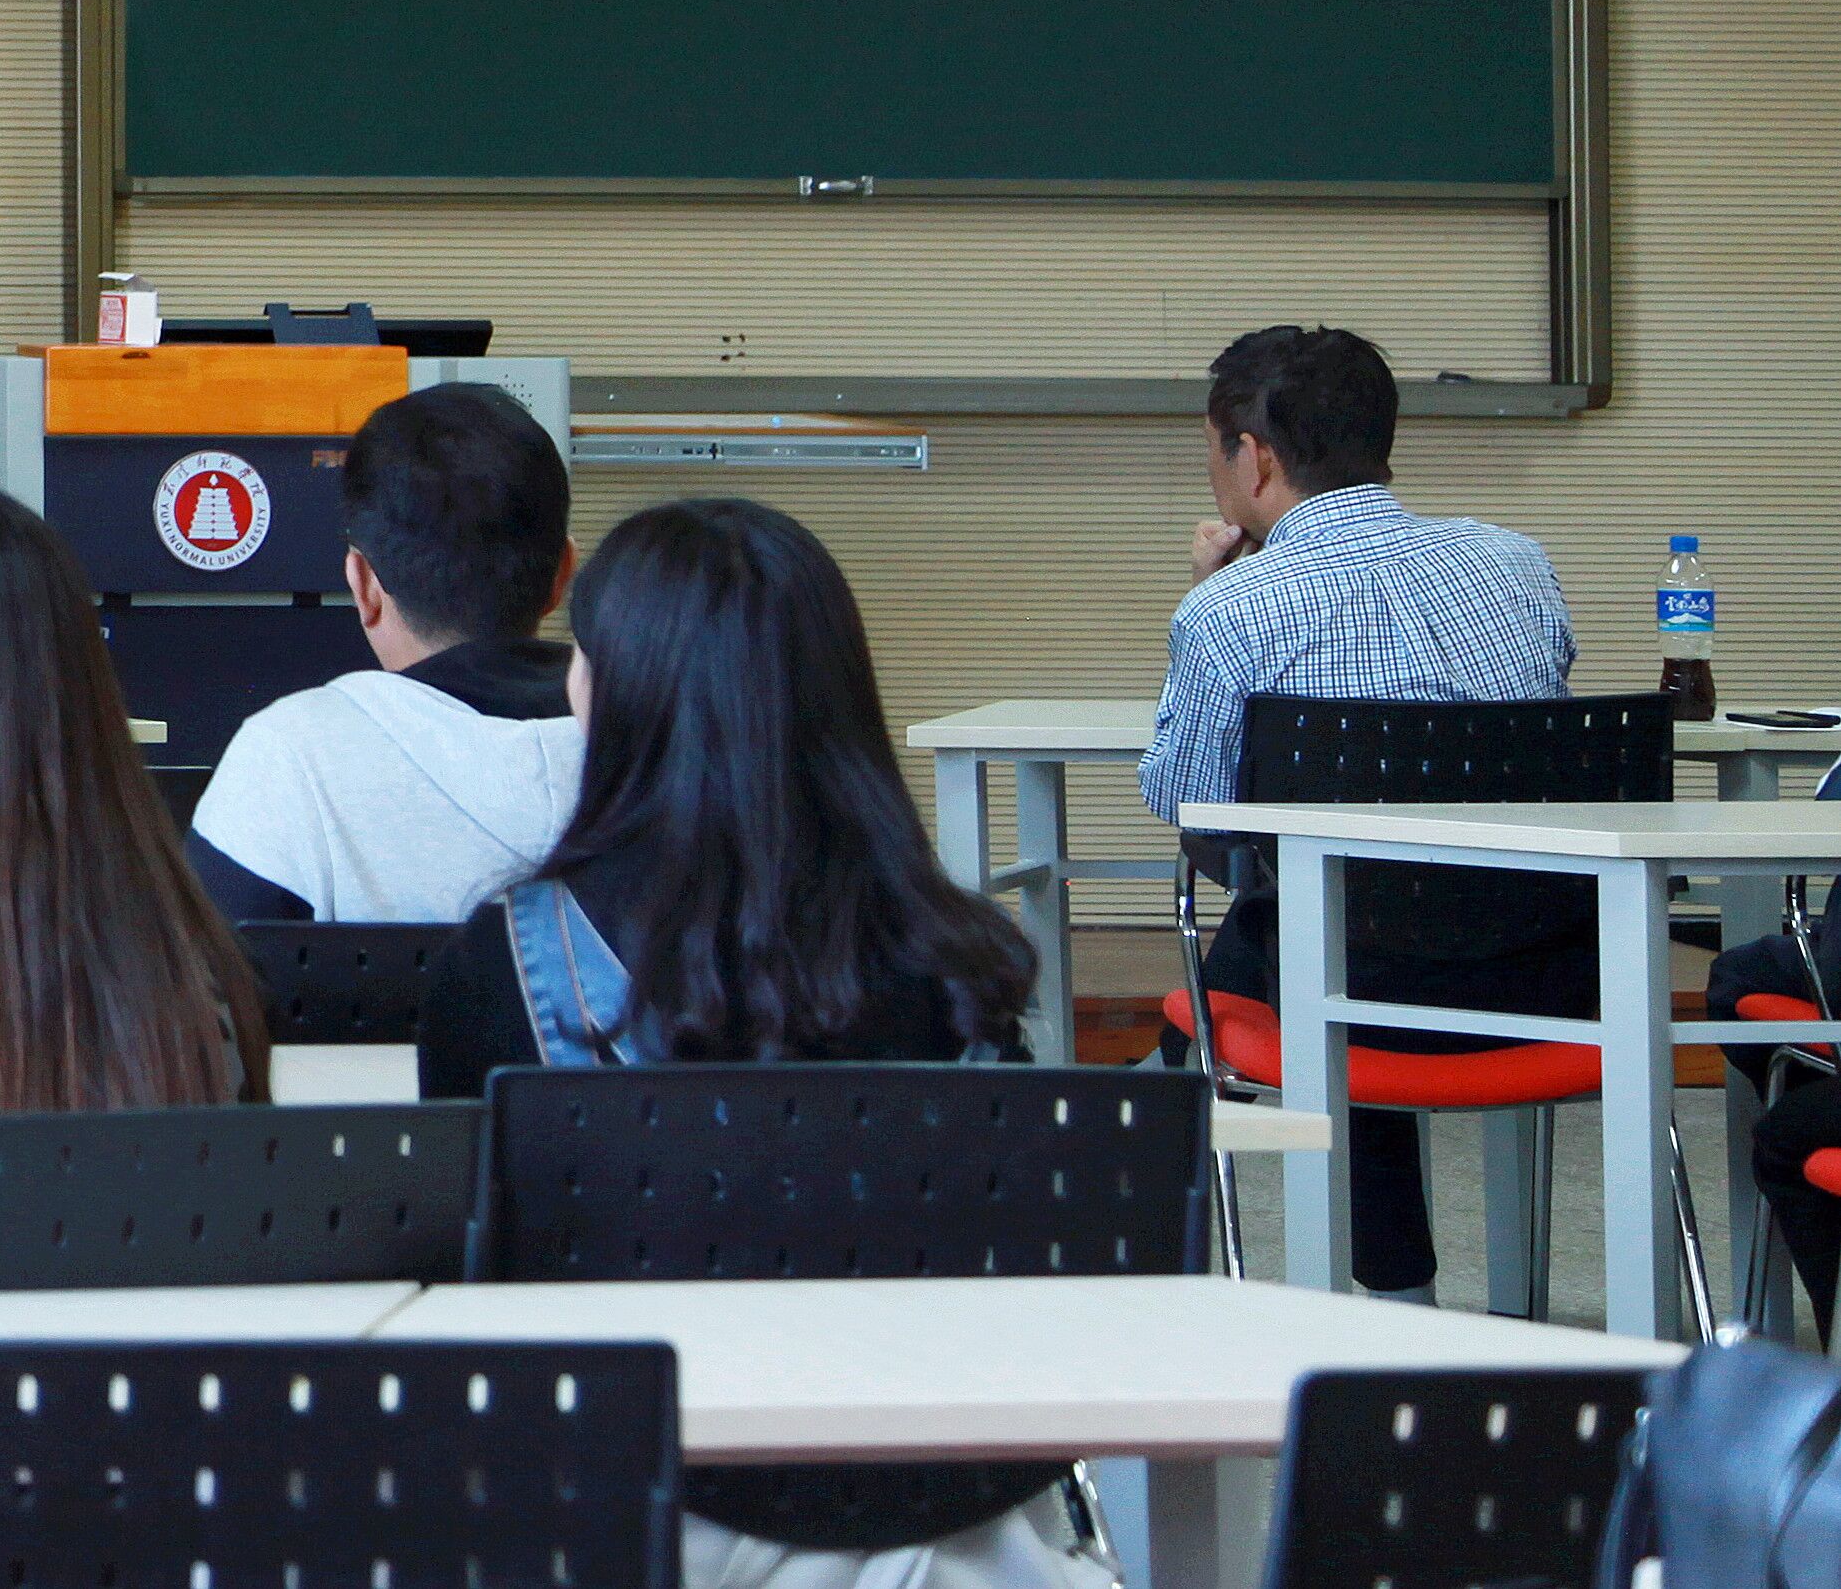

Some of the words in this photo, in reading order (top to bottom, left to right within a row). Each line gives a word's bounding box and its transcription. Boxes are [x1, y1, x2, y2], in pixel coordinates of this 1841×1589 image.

[160, 503, 171, 534] YUXI
[169, 535, 214, 566] NORMAL
[218, 507, 266, 566] UNIVERSITY
